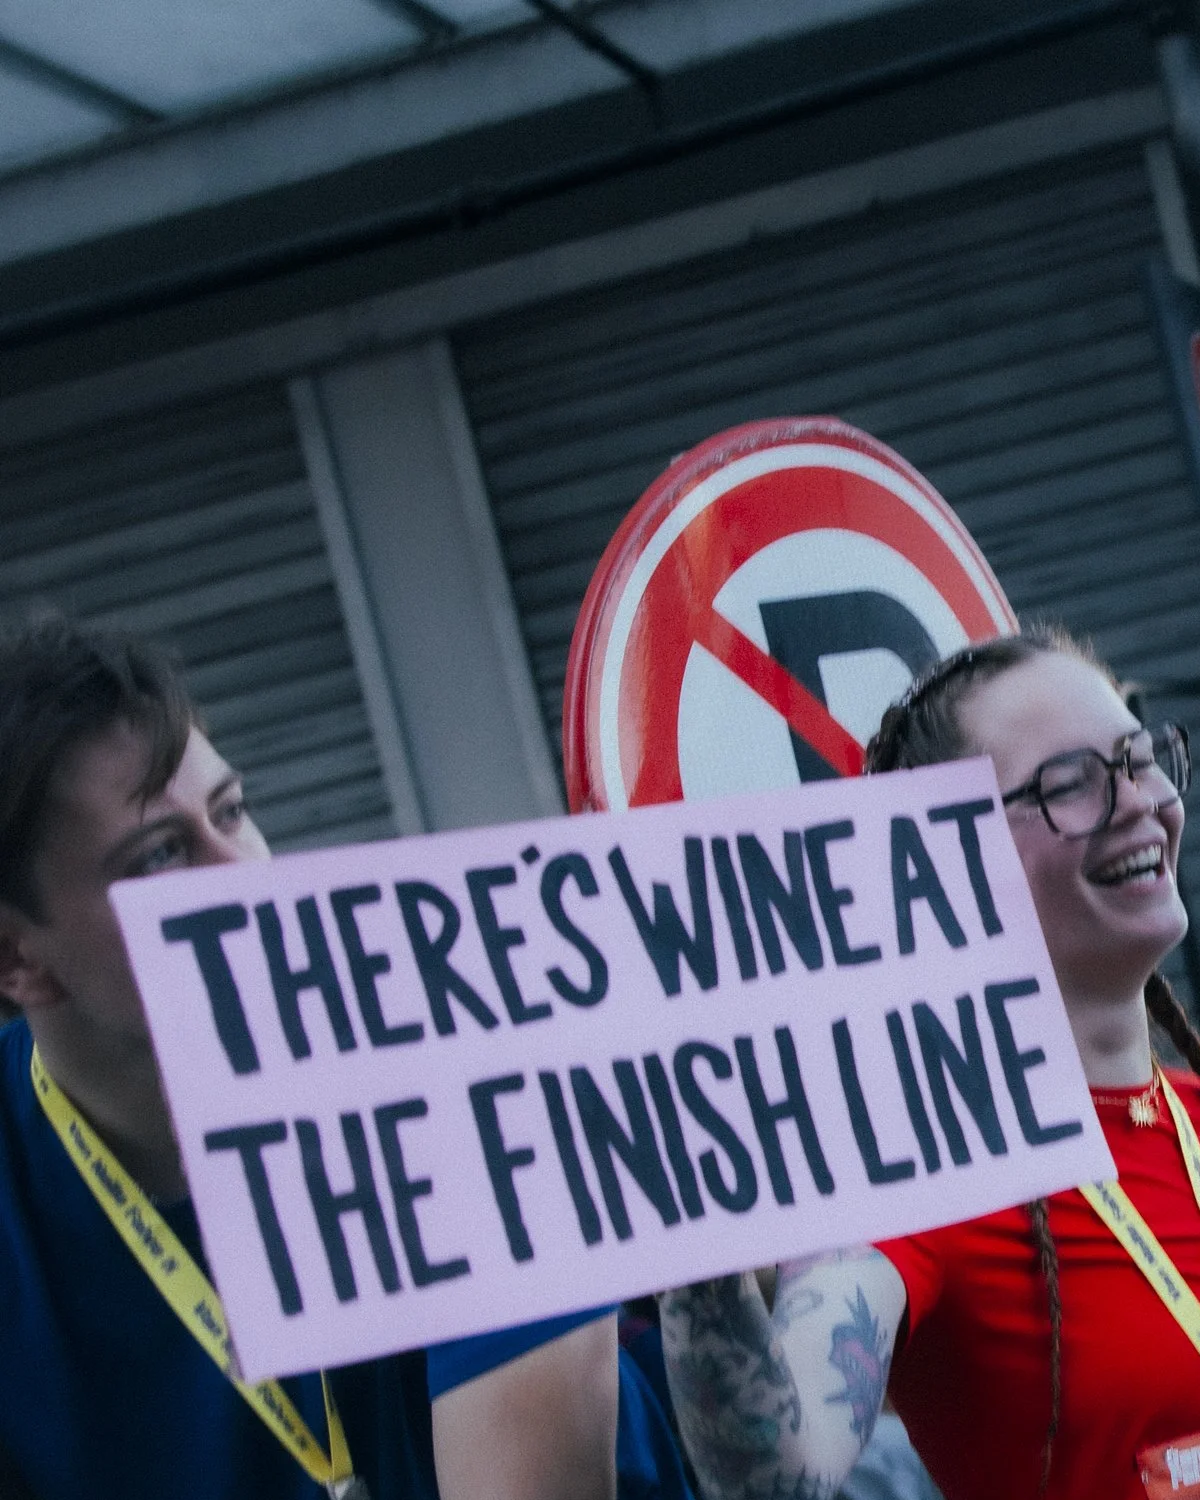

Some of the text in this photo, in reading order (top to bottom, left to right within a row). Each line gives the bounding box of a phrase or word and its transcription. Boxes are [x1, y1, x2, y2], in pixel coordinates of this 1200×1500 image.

[161, 798, 1003, 1075] THERE'S WINE AT
[204, 1099, 470, 1316] THE
[469, 1026, 835, 1263] FINISH
[831, 978, 1083, 1185] LINE
